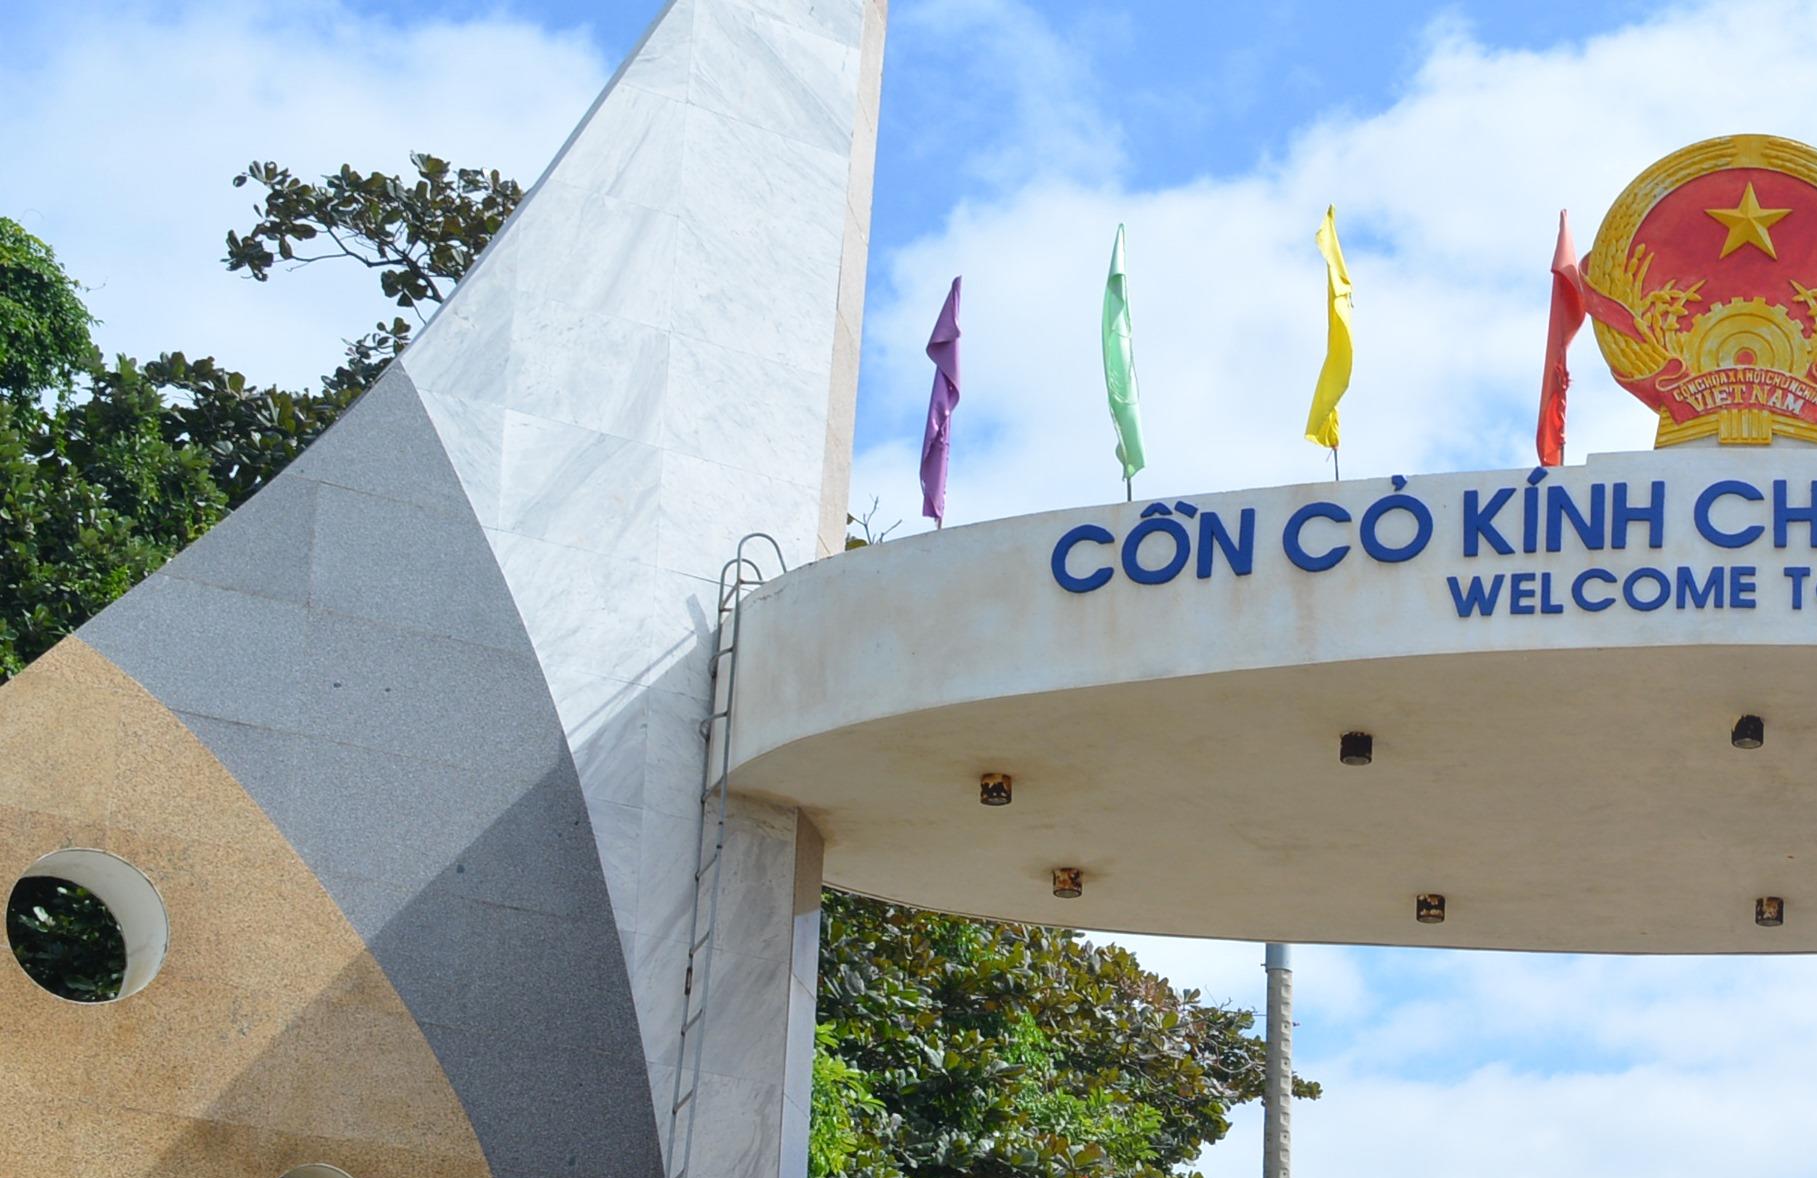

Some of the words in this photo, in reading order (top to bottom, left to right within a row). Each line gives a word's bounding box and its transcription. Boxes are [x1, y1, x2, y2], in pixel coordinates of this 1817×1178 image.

[1749, 385, 1805, 415] NAM
[1051, 501, 1256, 593] CỒN
[1283, 475, 1433, 572] CỎ
[1463, 467, 1665, 557] KÍNH
[1447, 567, 1757, 617] WELCOME
